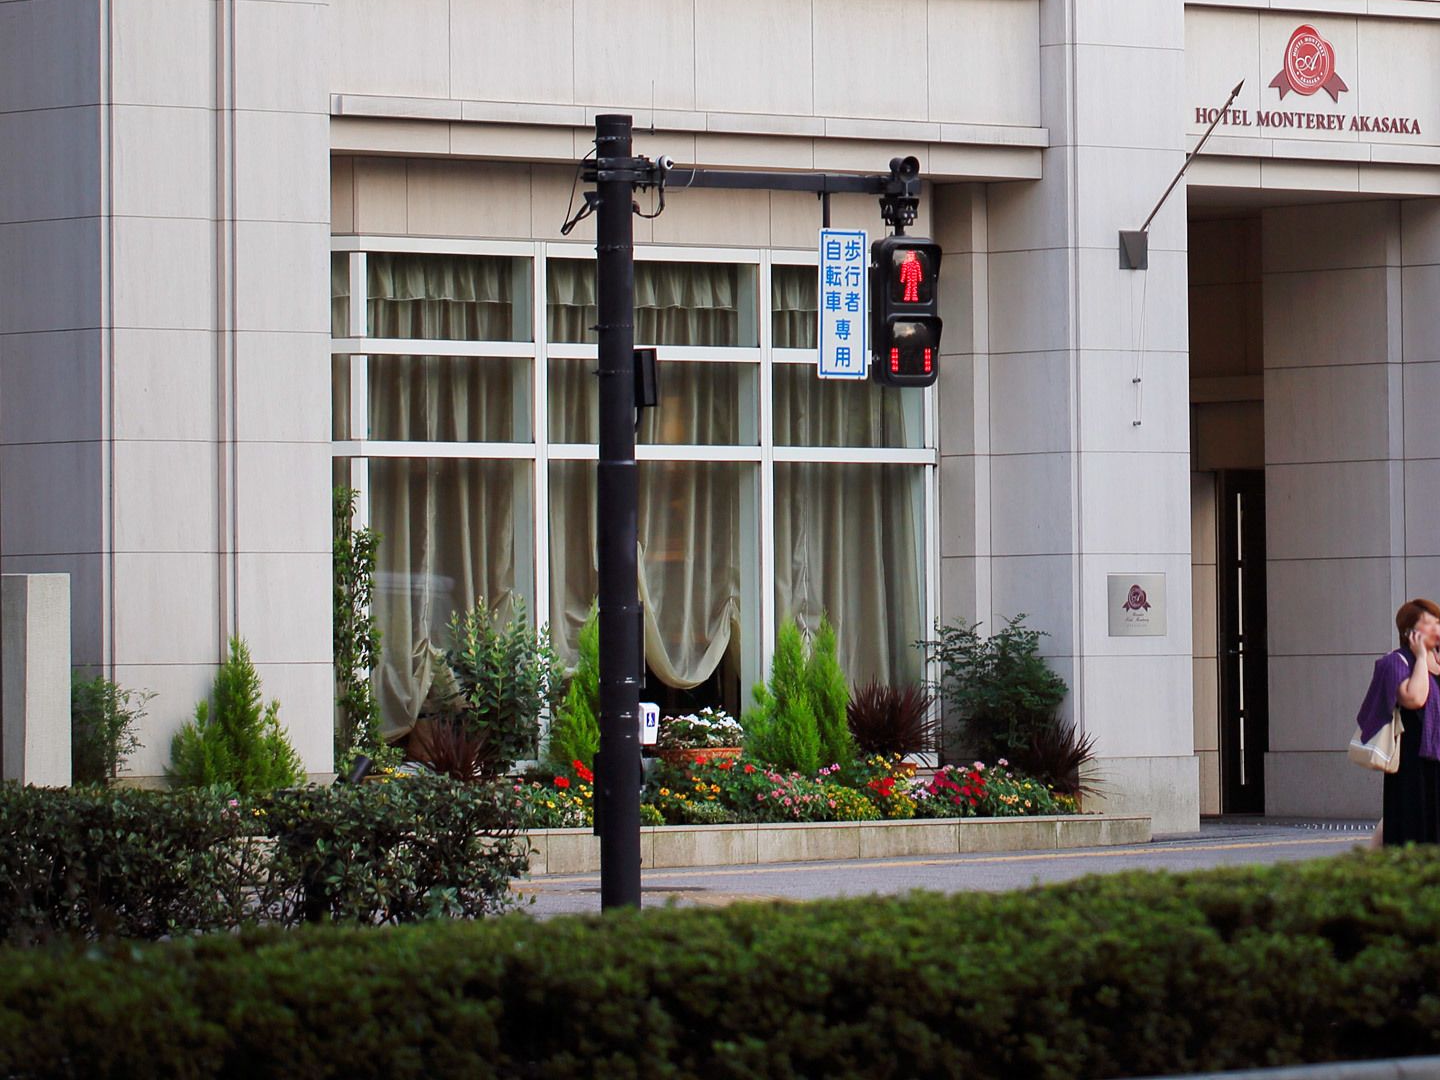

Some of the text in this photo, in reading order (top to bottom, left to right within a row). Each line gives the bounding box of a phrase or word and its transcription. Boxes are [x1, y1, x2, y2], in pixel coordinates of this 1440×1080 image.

[1195, 107, 1421, 135] HOTEL MONTEREY AKASAKA
[825, 239, 842, 313] 自転車
[844, 239, 861, 313] 歩行者
[834, 318, 851, 368] 専用
